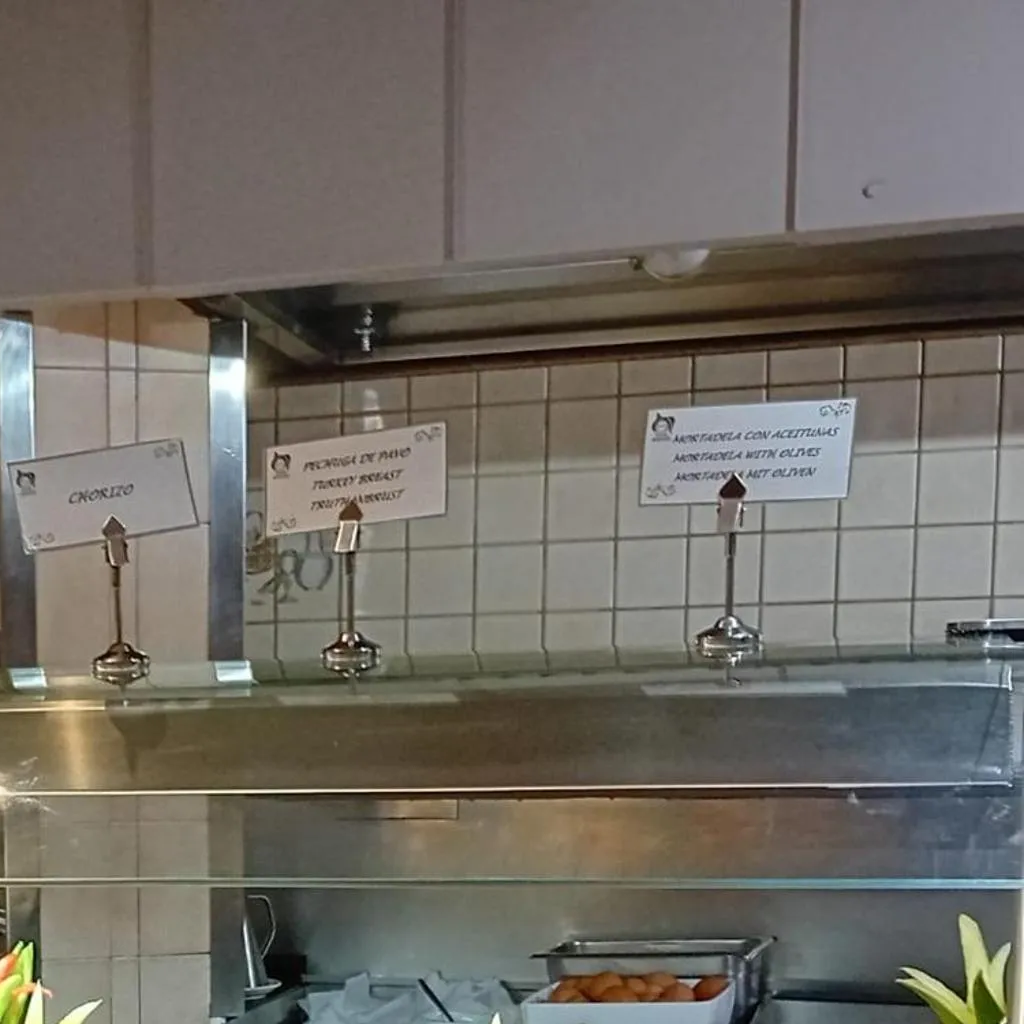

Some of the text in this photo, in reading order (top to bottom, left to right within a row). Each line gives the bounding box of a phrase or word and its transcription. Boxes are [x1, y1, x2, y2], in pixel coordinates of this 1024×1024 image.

[672, 426, 840, 444] MORTADELA CON ACEITUNAS
[303, 447, 412, 472] PECHUGA DE PAVO
[672, 447, 821, 463] MORTADELA WITH OLIVES
[312, 469, 404, 490] TURKEY BREAST
[674, 466, 817, 482] MORTADEA MIT OLIVEN
[68, 483, 134, 504] CHORIZO
